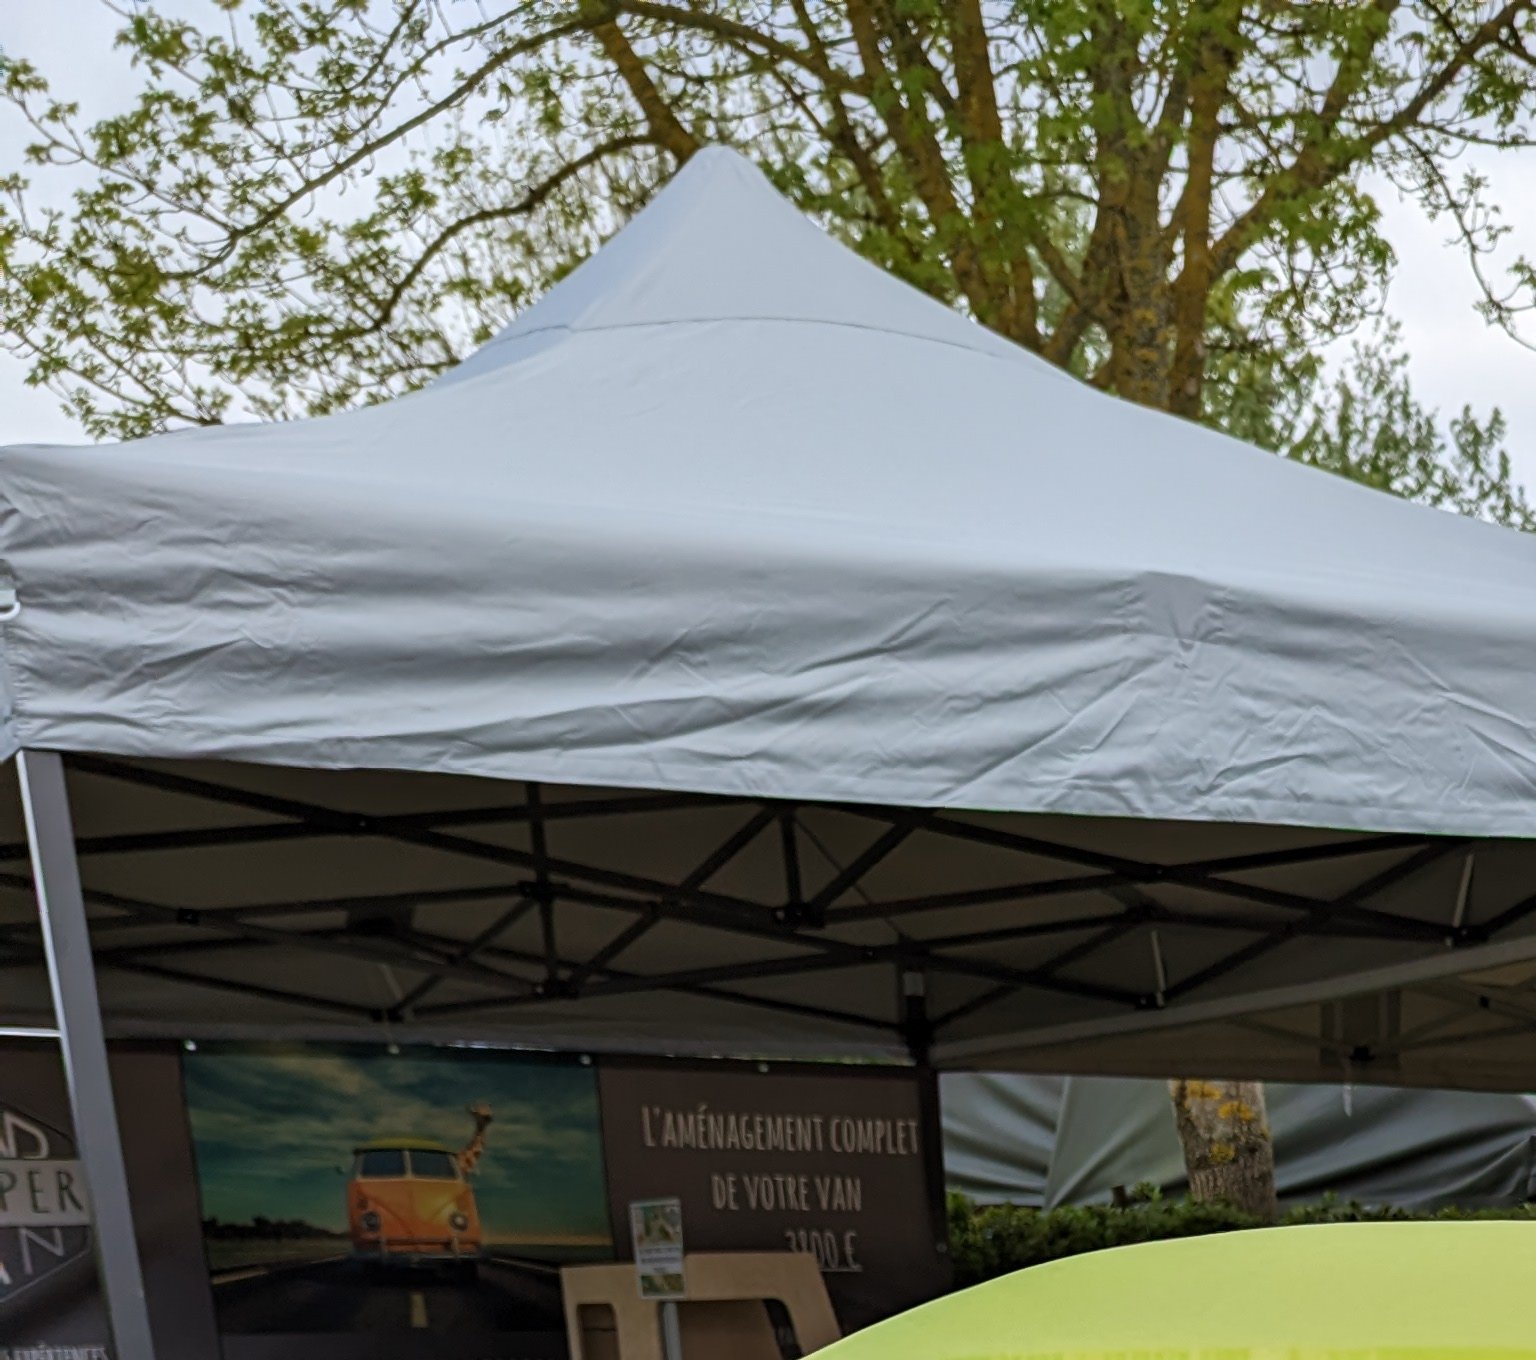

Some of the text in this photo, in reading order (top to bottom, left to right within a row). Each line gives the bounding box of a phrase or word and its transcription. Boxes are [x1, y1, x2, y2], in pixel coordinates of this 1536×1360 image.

[641, 1104, 919, 1155] L'AMÉNAGEMENT COMPLET
[711, 1172, 863, 1213] DE VOTRE VAN
